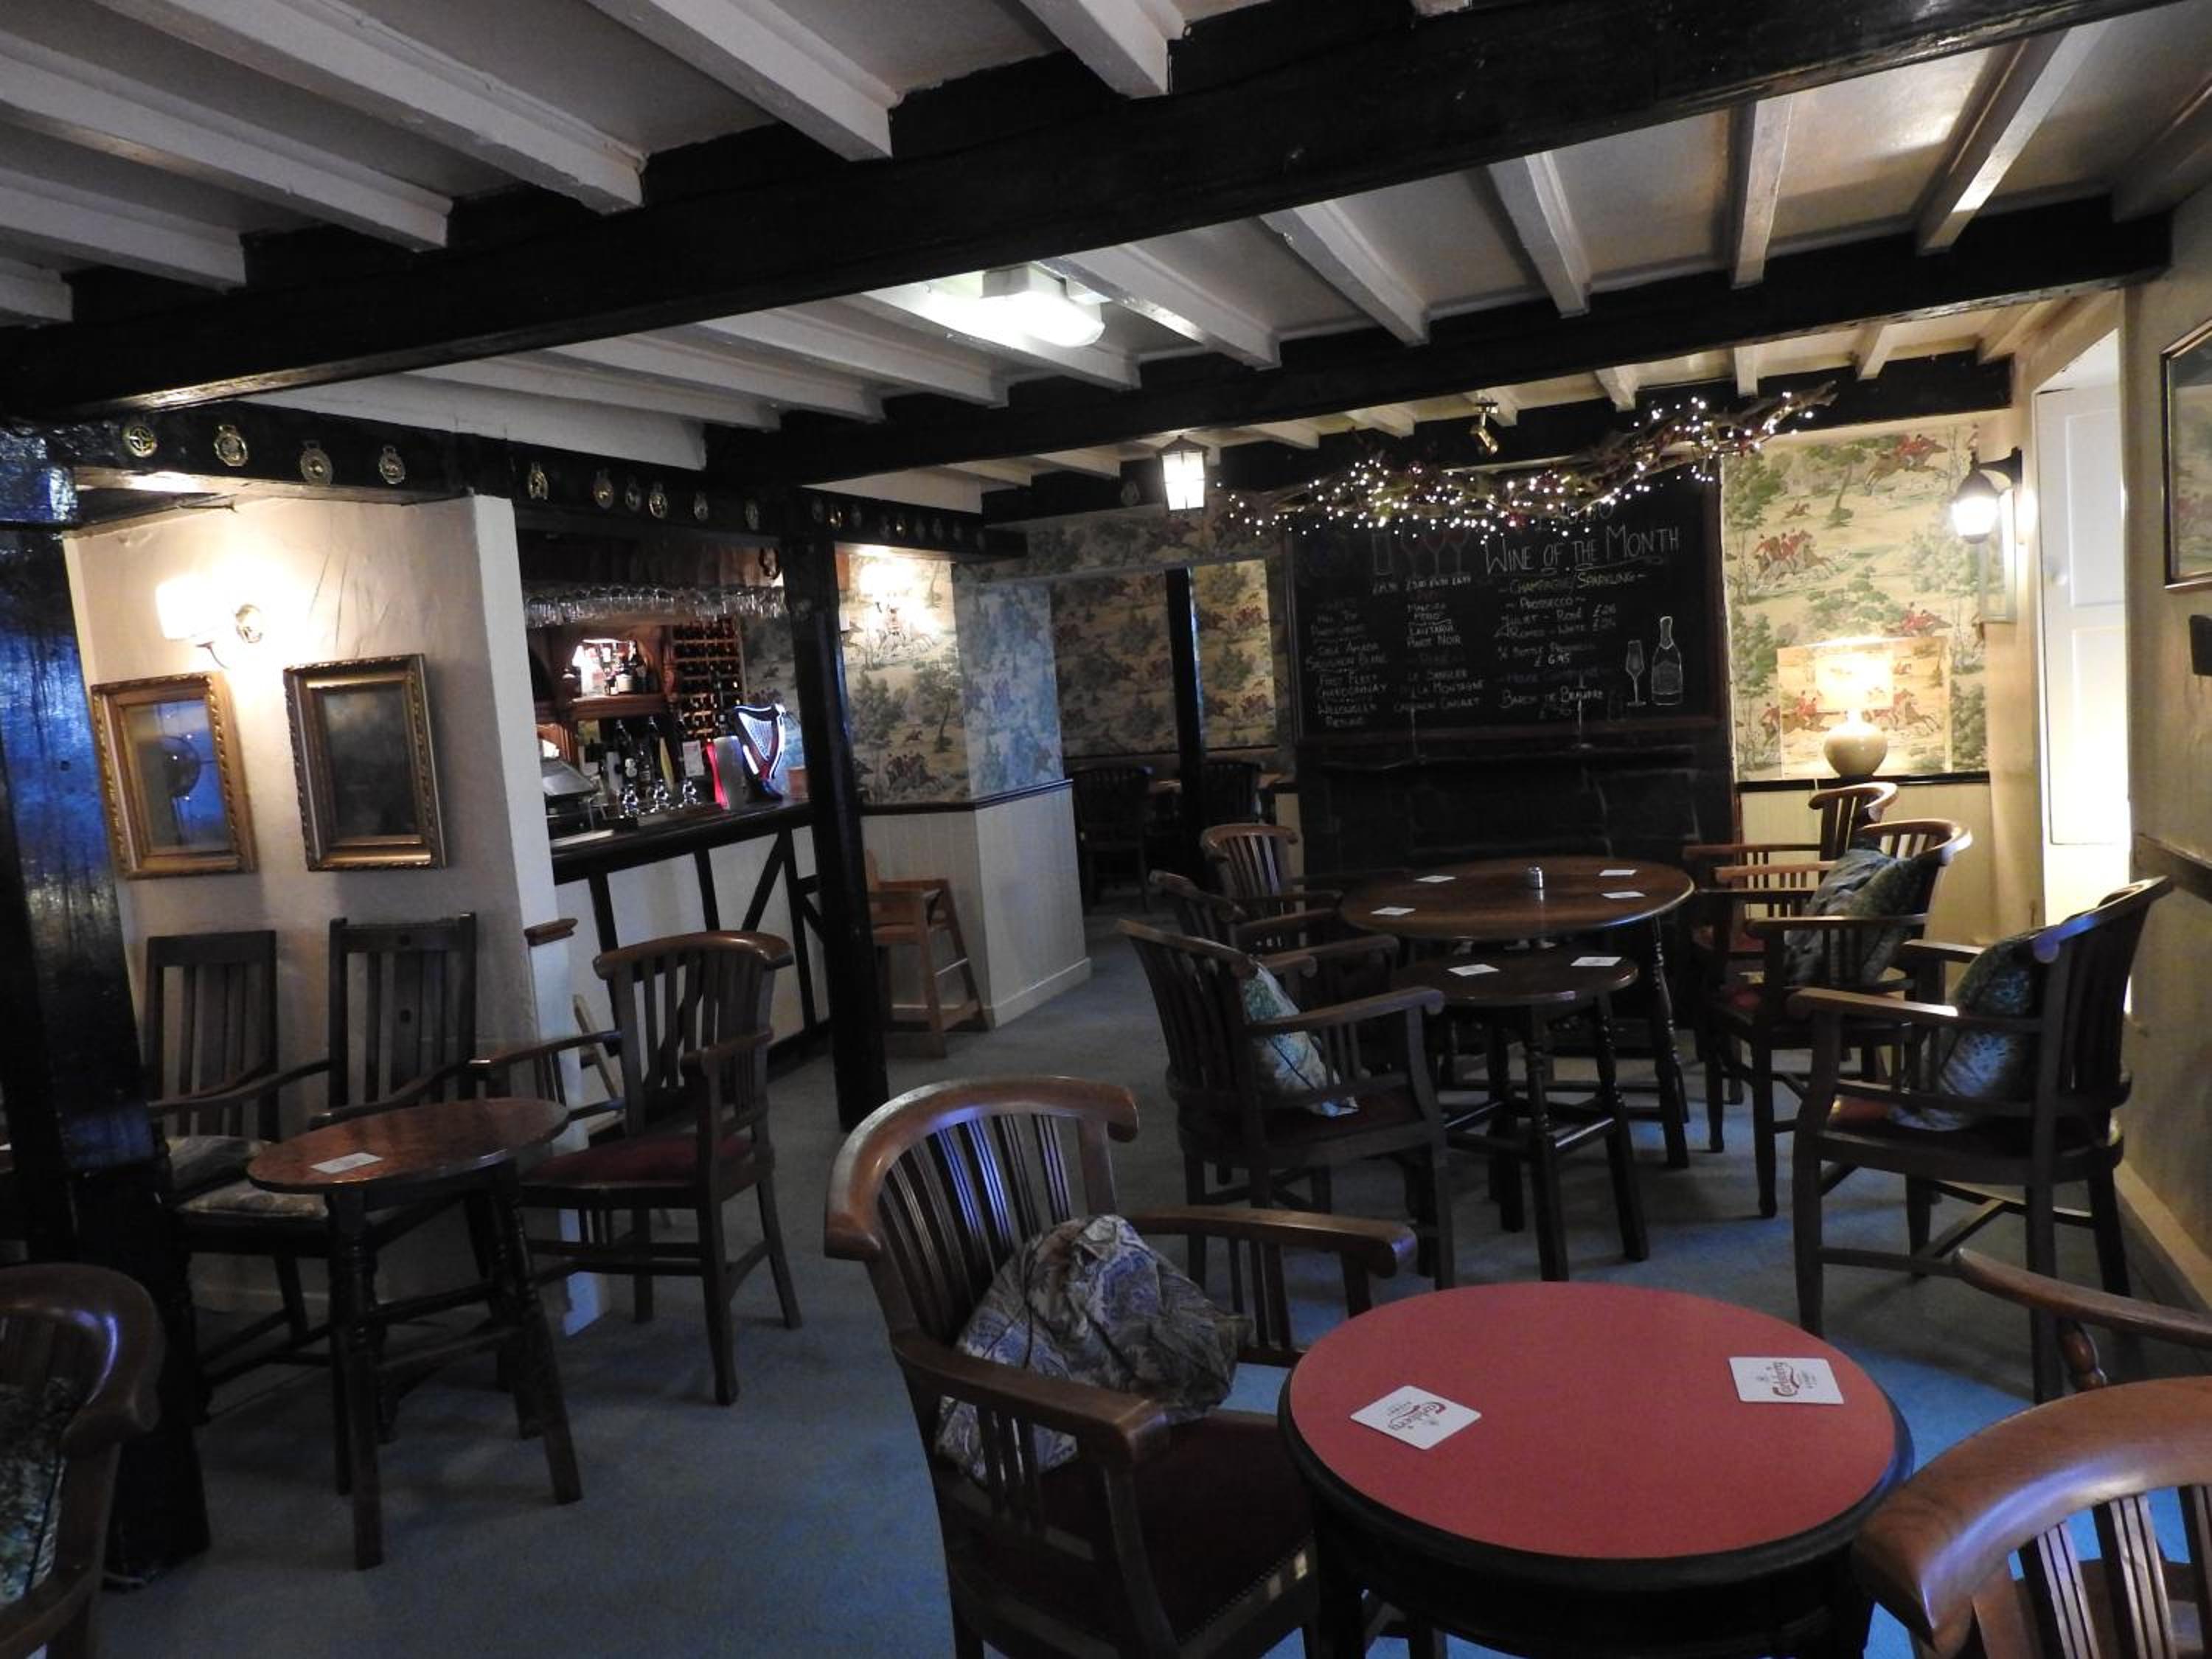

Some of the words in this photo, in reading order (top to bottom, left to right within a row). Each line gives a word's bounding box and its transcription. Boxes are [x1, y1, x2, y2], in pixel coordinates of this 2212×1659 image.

[1484, 537, 1534, 575] WINE
[1543, 543, 1564, 567] OF
[1572, 540, 1599, 566] THE
[1606, 524, 1680, 561] MONTH
